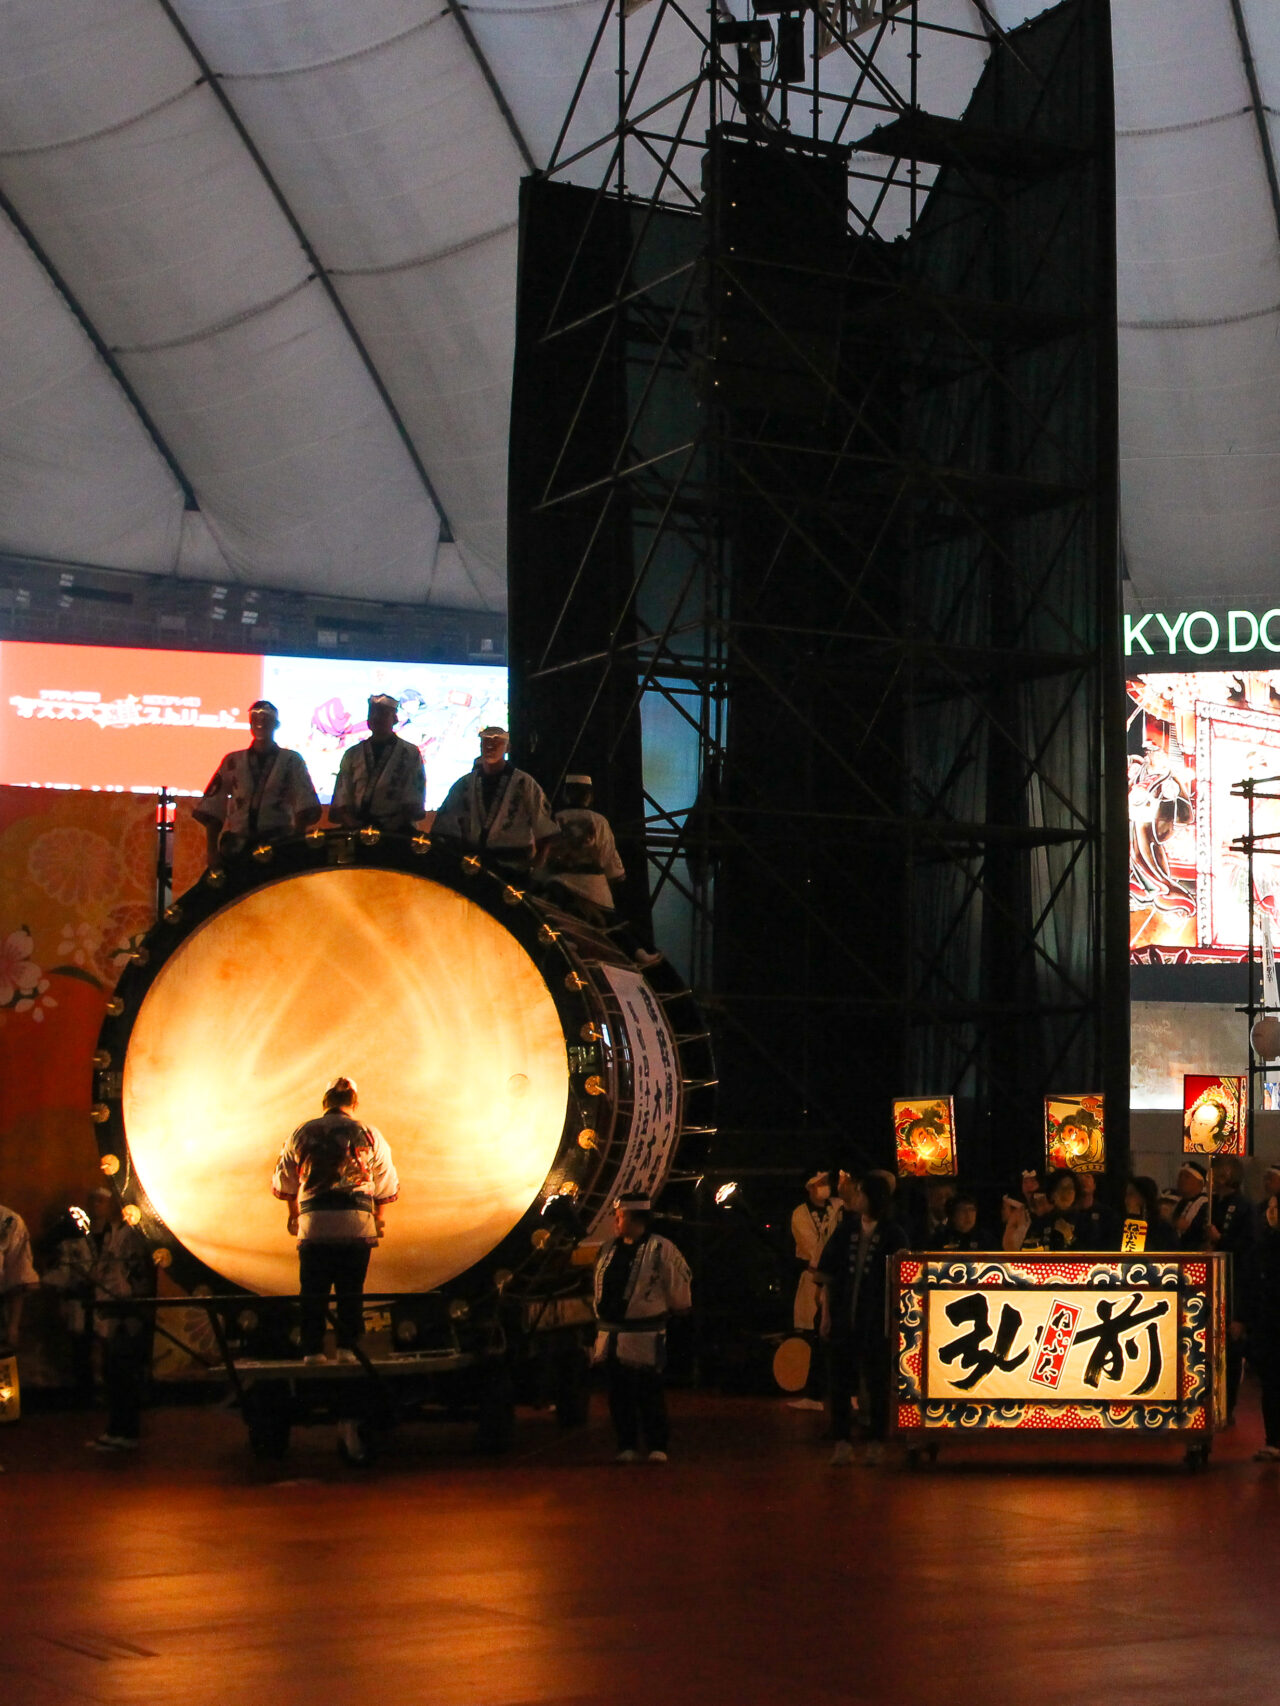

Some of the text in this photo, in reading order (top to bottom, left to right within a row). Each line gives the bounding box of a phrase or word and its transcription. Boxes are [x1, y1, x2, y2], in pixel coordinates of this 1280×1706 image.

[1124, 611, 1220, 656] KYO
[938, 1292, 1169, 1395] 弘前
[1037, 1309, 1072, 1383] ねぷた
